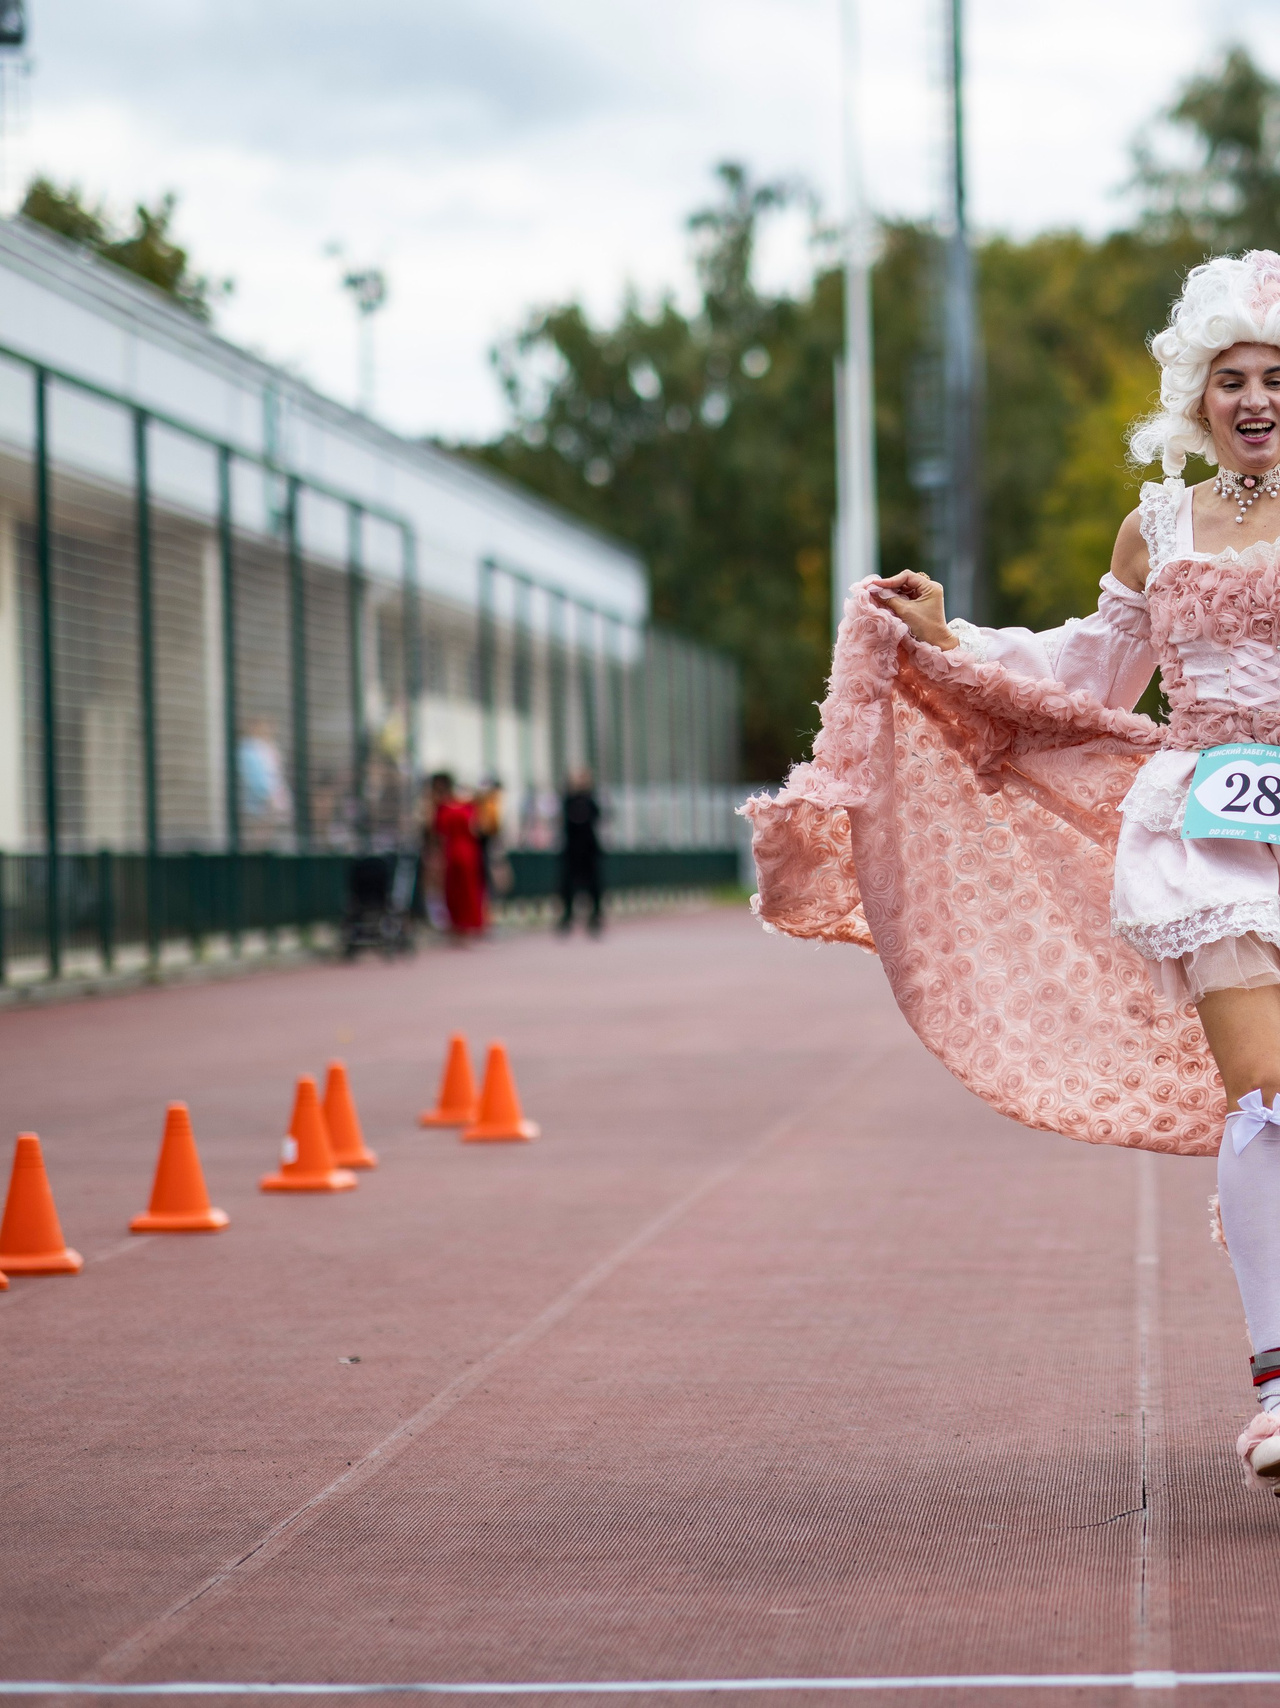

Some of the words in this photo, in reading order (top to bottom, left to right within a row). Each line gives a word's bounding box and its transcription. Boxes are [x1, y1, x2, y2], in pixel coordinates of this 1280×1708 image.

[1208, 748, 1241, 758] ЖЕНСКИЙ
[1241, 748, 1265, 756] ЗАБЕГ
[1266, 749, 1277, 758] НА
[1220, 828, 1246, 836] EVENT
